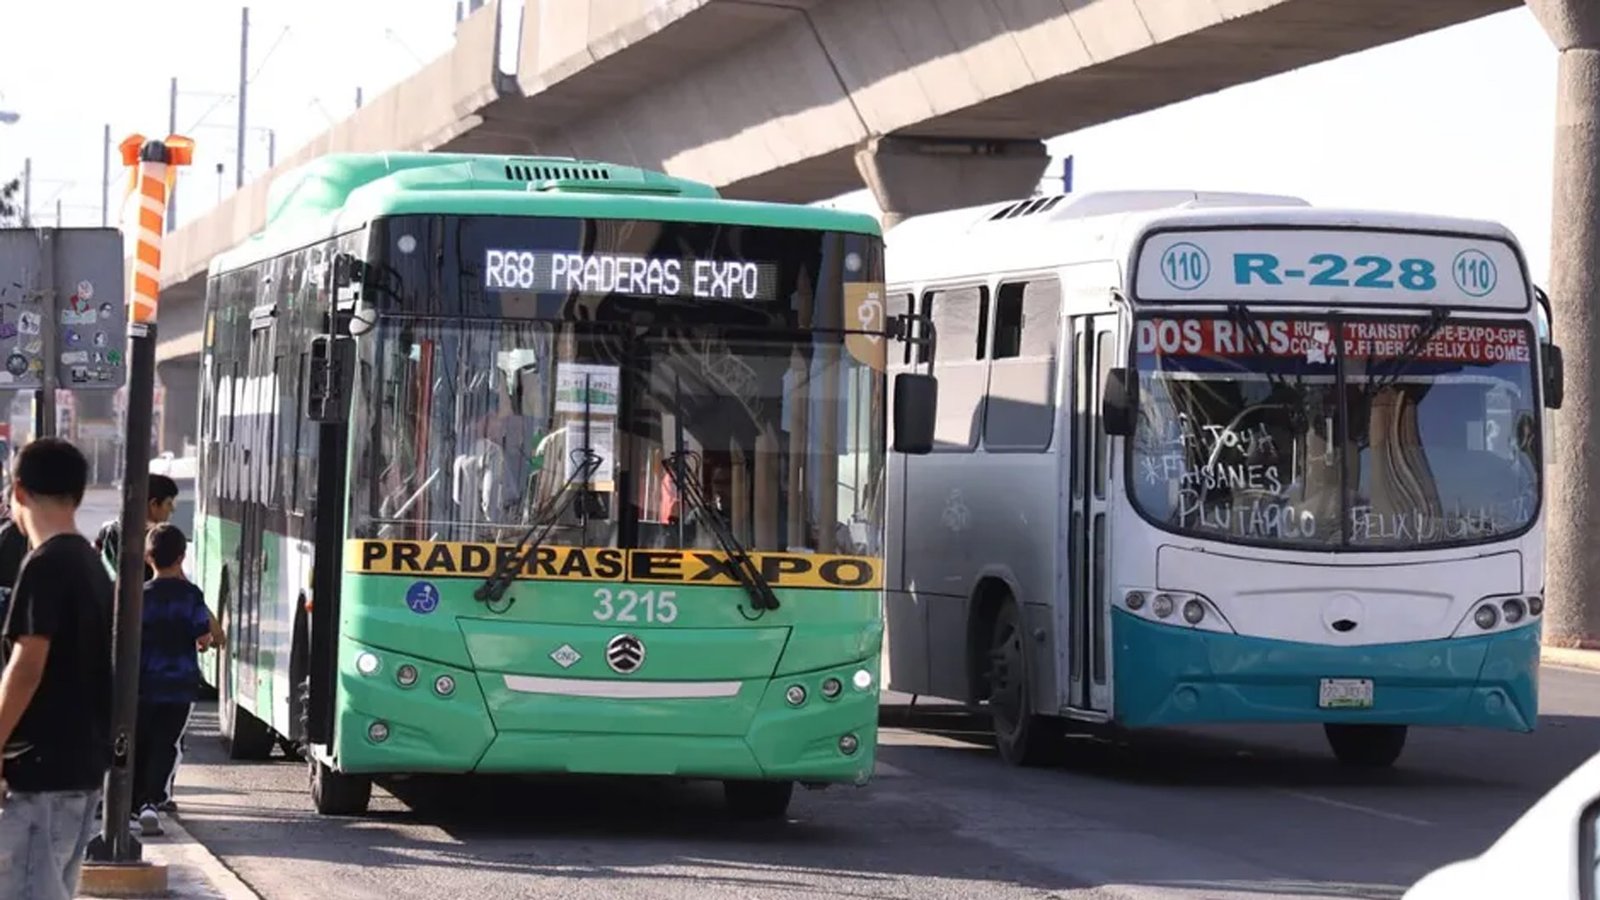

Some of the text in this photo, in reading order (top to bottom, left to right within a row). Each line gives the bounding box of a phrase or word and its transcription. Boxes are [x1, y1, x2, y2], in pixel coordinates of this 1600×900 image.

[486, 250, 758, 299] R68 PRADERAS EXPO
[1166, 251, 1200, 281] 110
[1232, 253, 1437, 292] R-228
[1457, 257, 1489, 290] 110
[1137, 319, 1203, 354] DOS
[361, 541, 875, 588] PRADERAS EXPO
[592, 587, 678, 624] 3215
